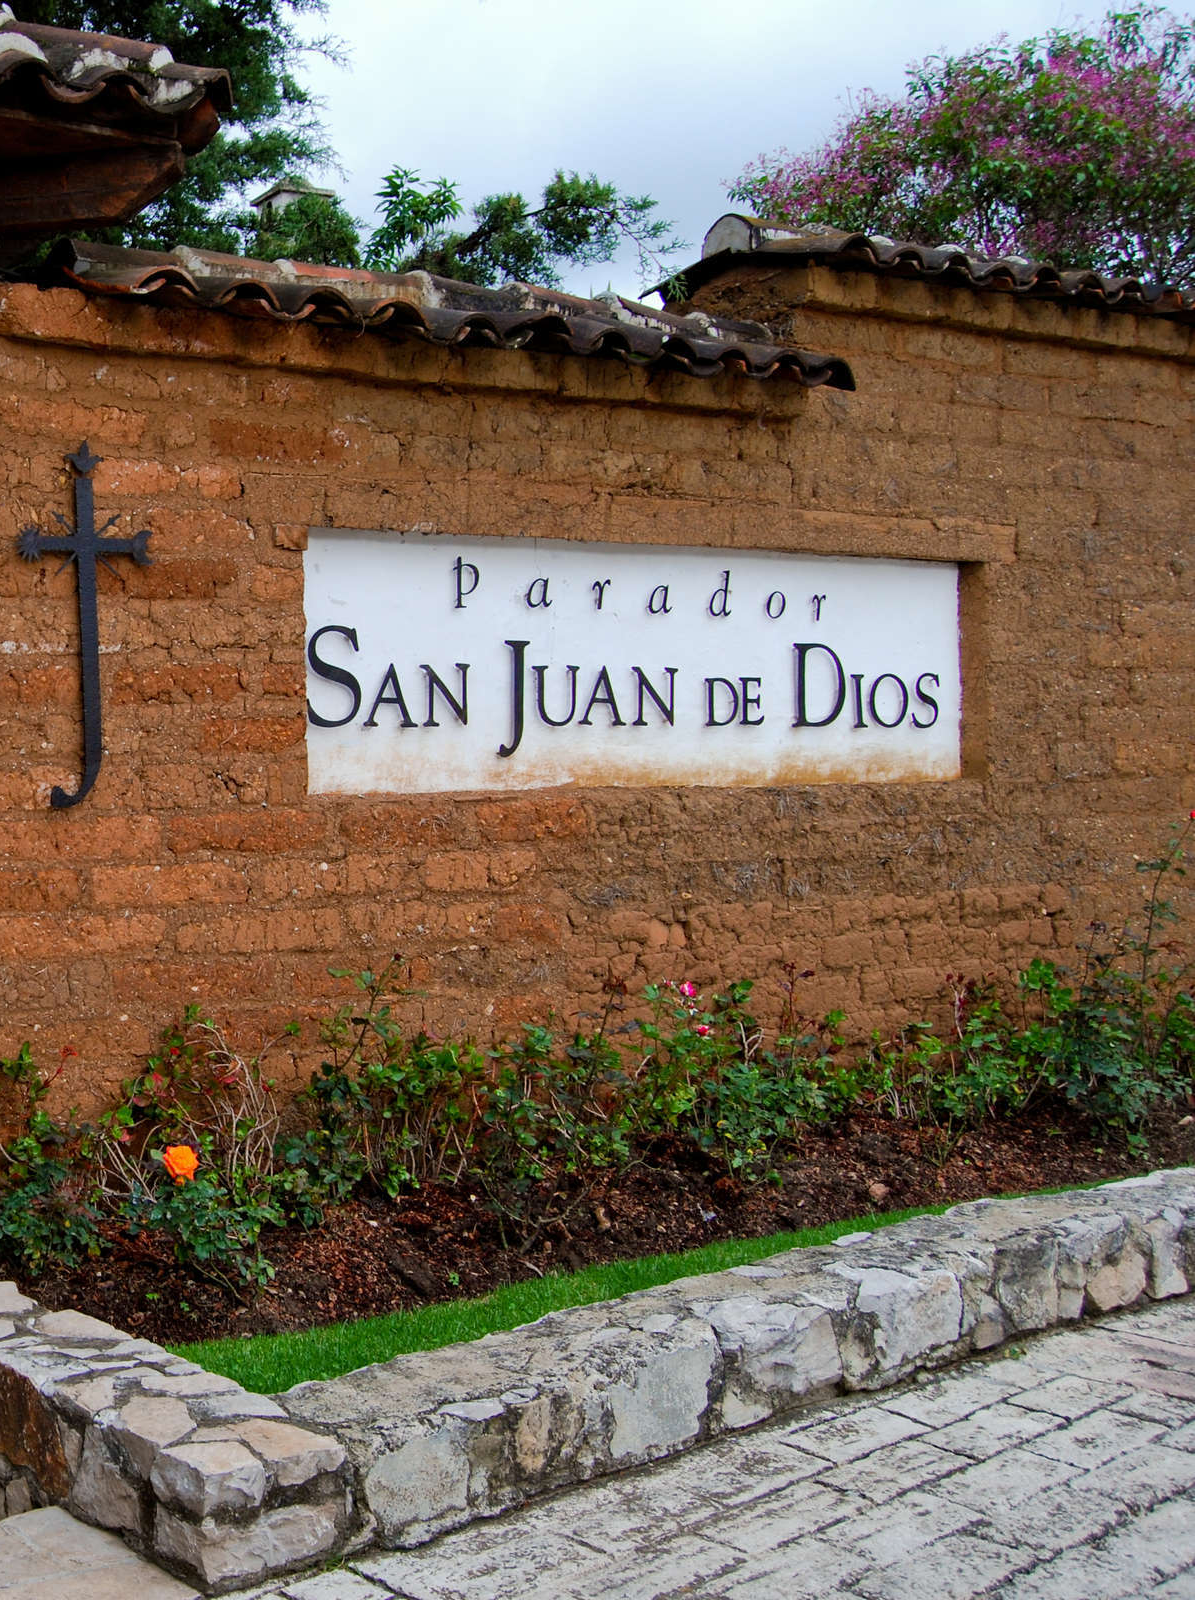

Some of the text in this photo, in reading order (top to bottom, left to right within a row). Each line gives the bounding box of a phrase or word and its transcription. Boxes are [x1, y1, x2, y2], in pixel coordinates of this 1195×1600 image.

[307, 625, 941, 758] SAN JUAN DE DIOS
